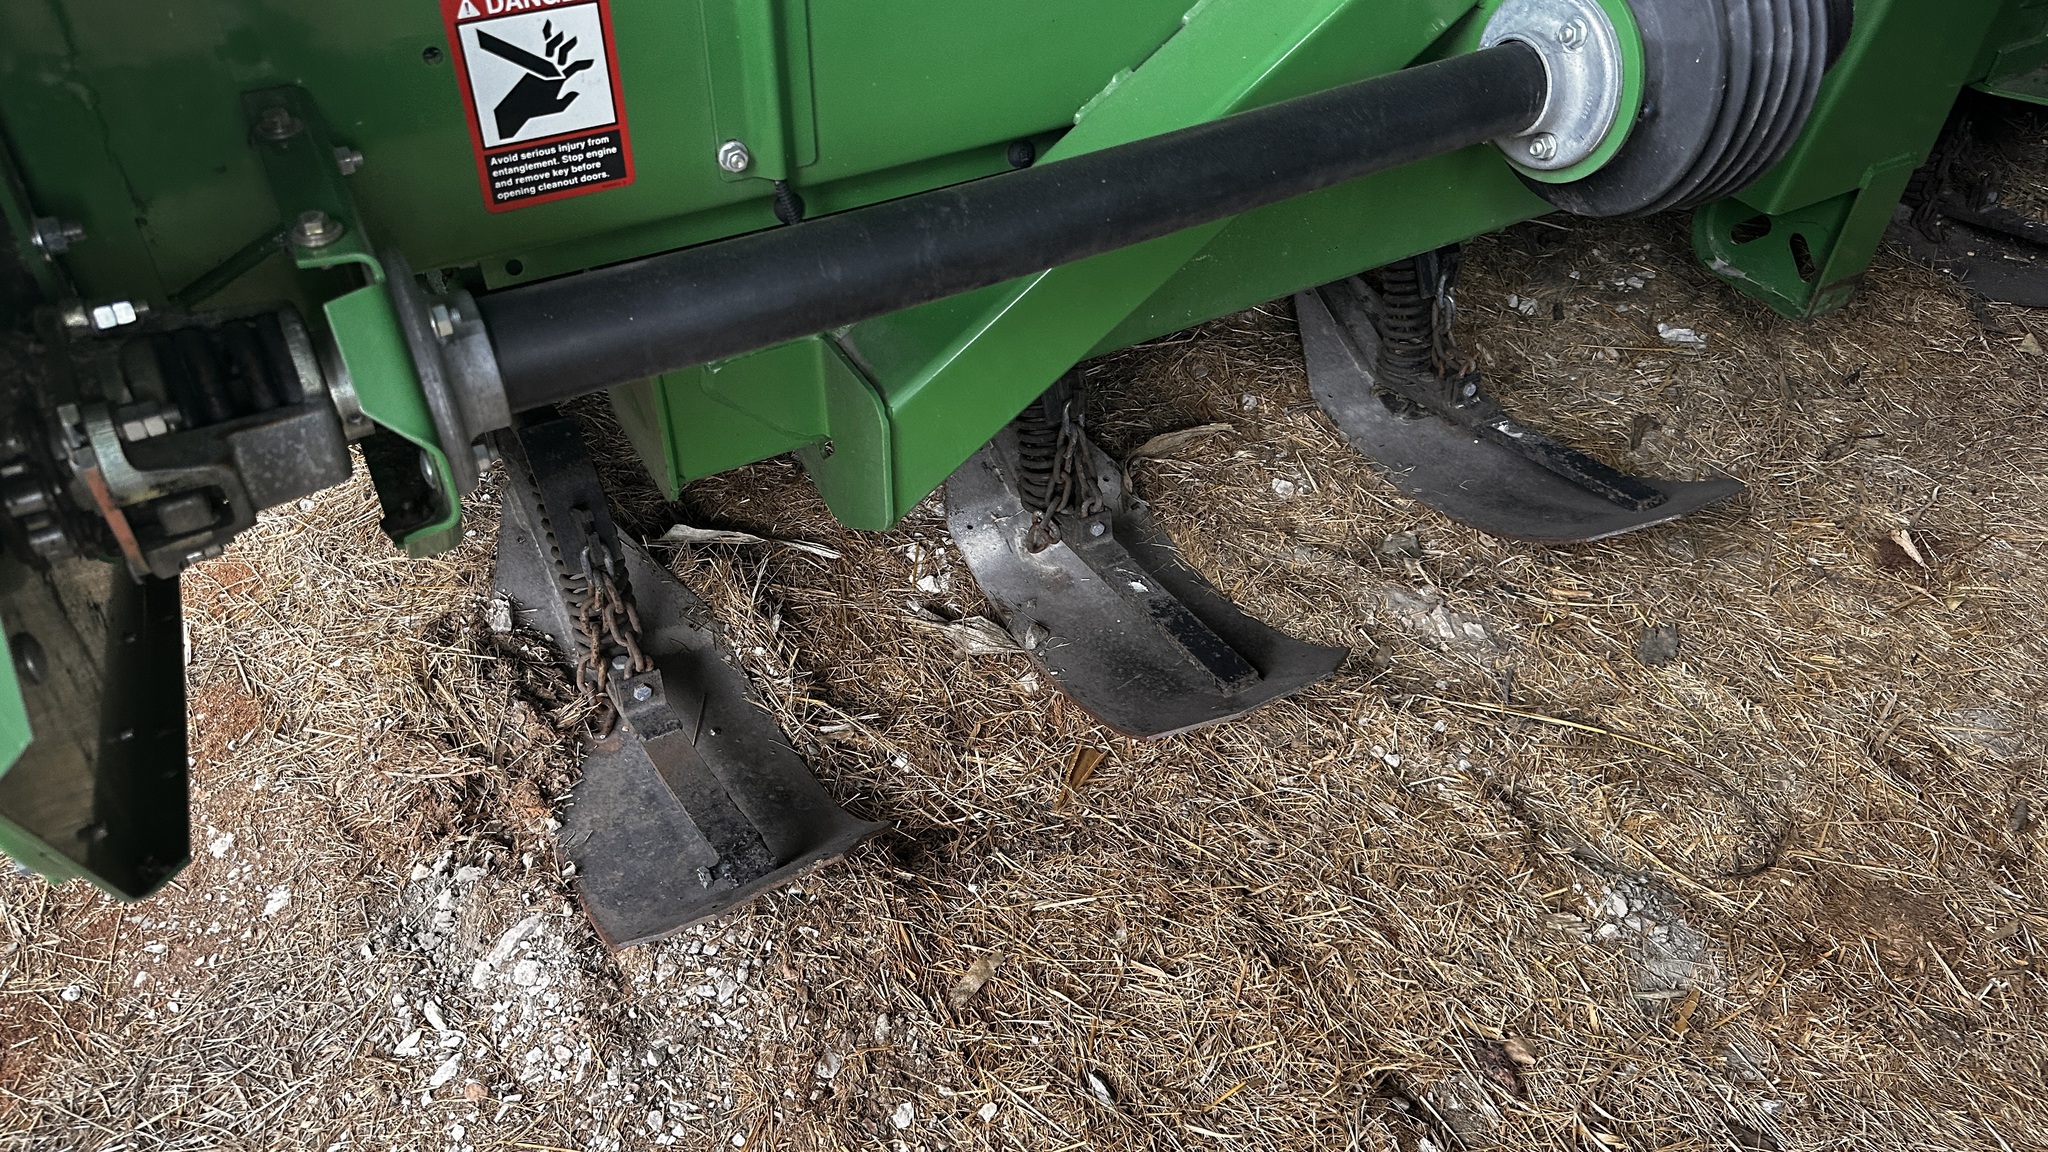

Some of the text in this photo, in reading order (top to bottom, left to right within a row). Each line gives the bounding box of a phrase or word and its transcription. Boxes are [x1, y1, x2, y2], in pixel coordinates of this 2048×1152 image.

[490, 136, 610, 166] Avoid serious injury from
[492, 146, 618, 177] entanglement. Stop engine
[494, 161, 602, 189] and remove key before
[497, 171, 610, 200] opening cleanout doors.
